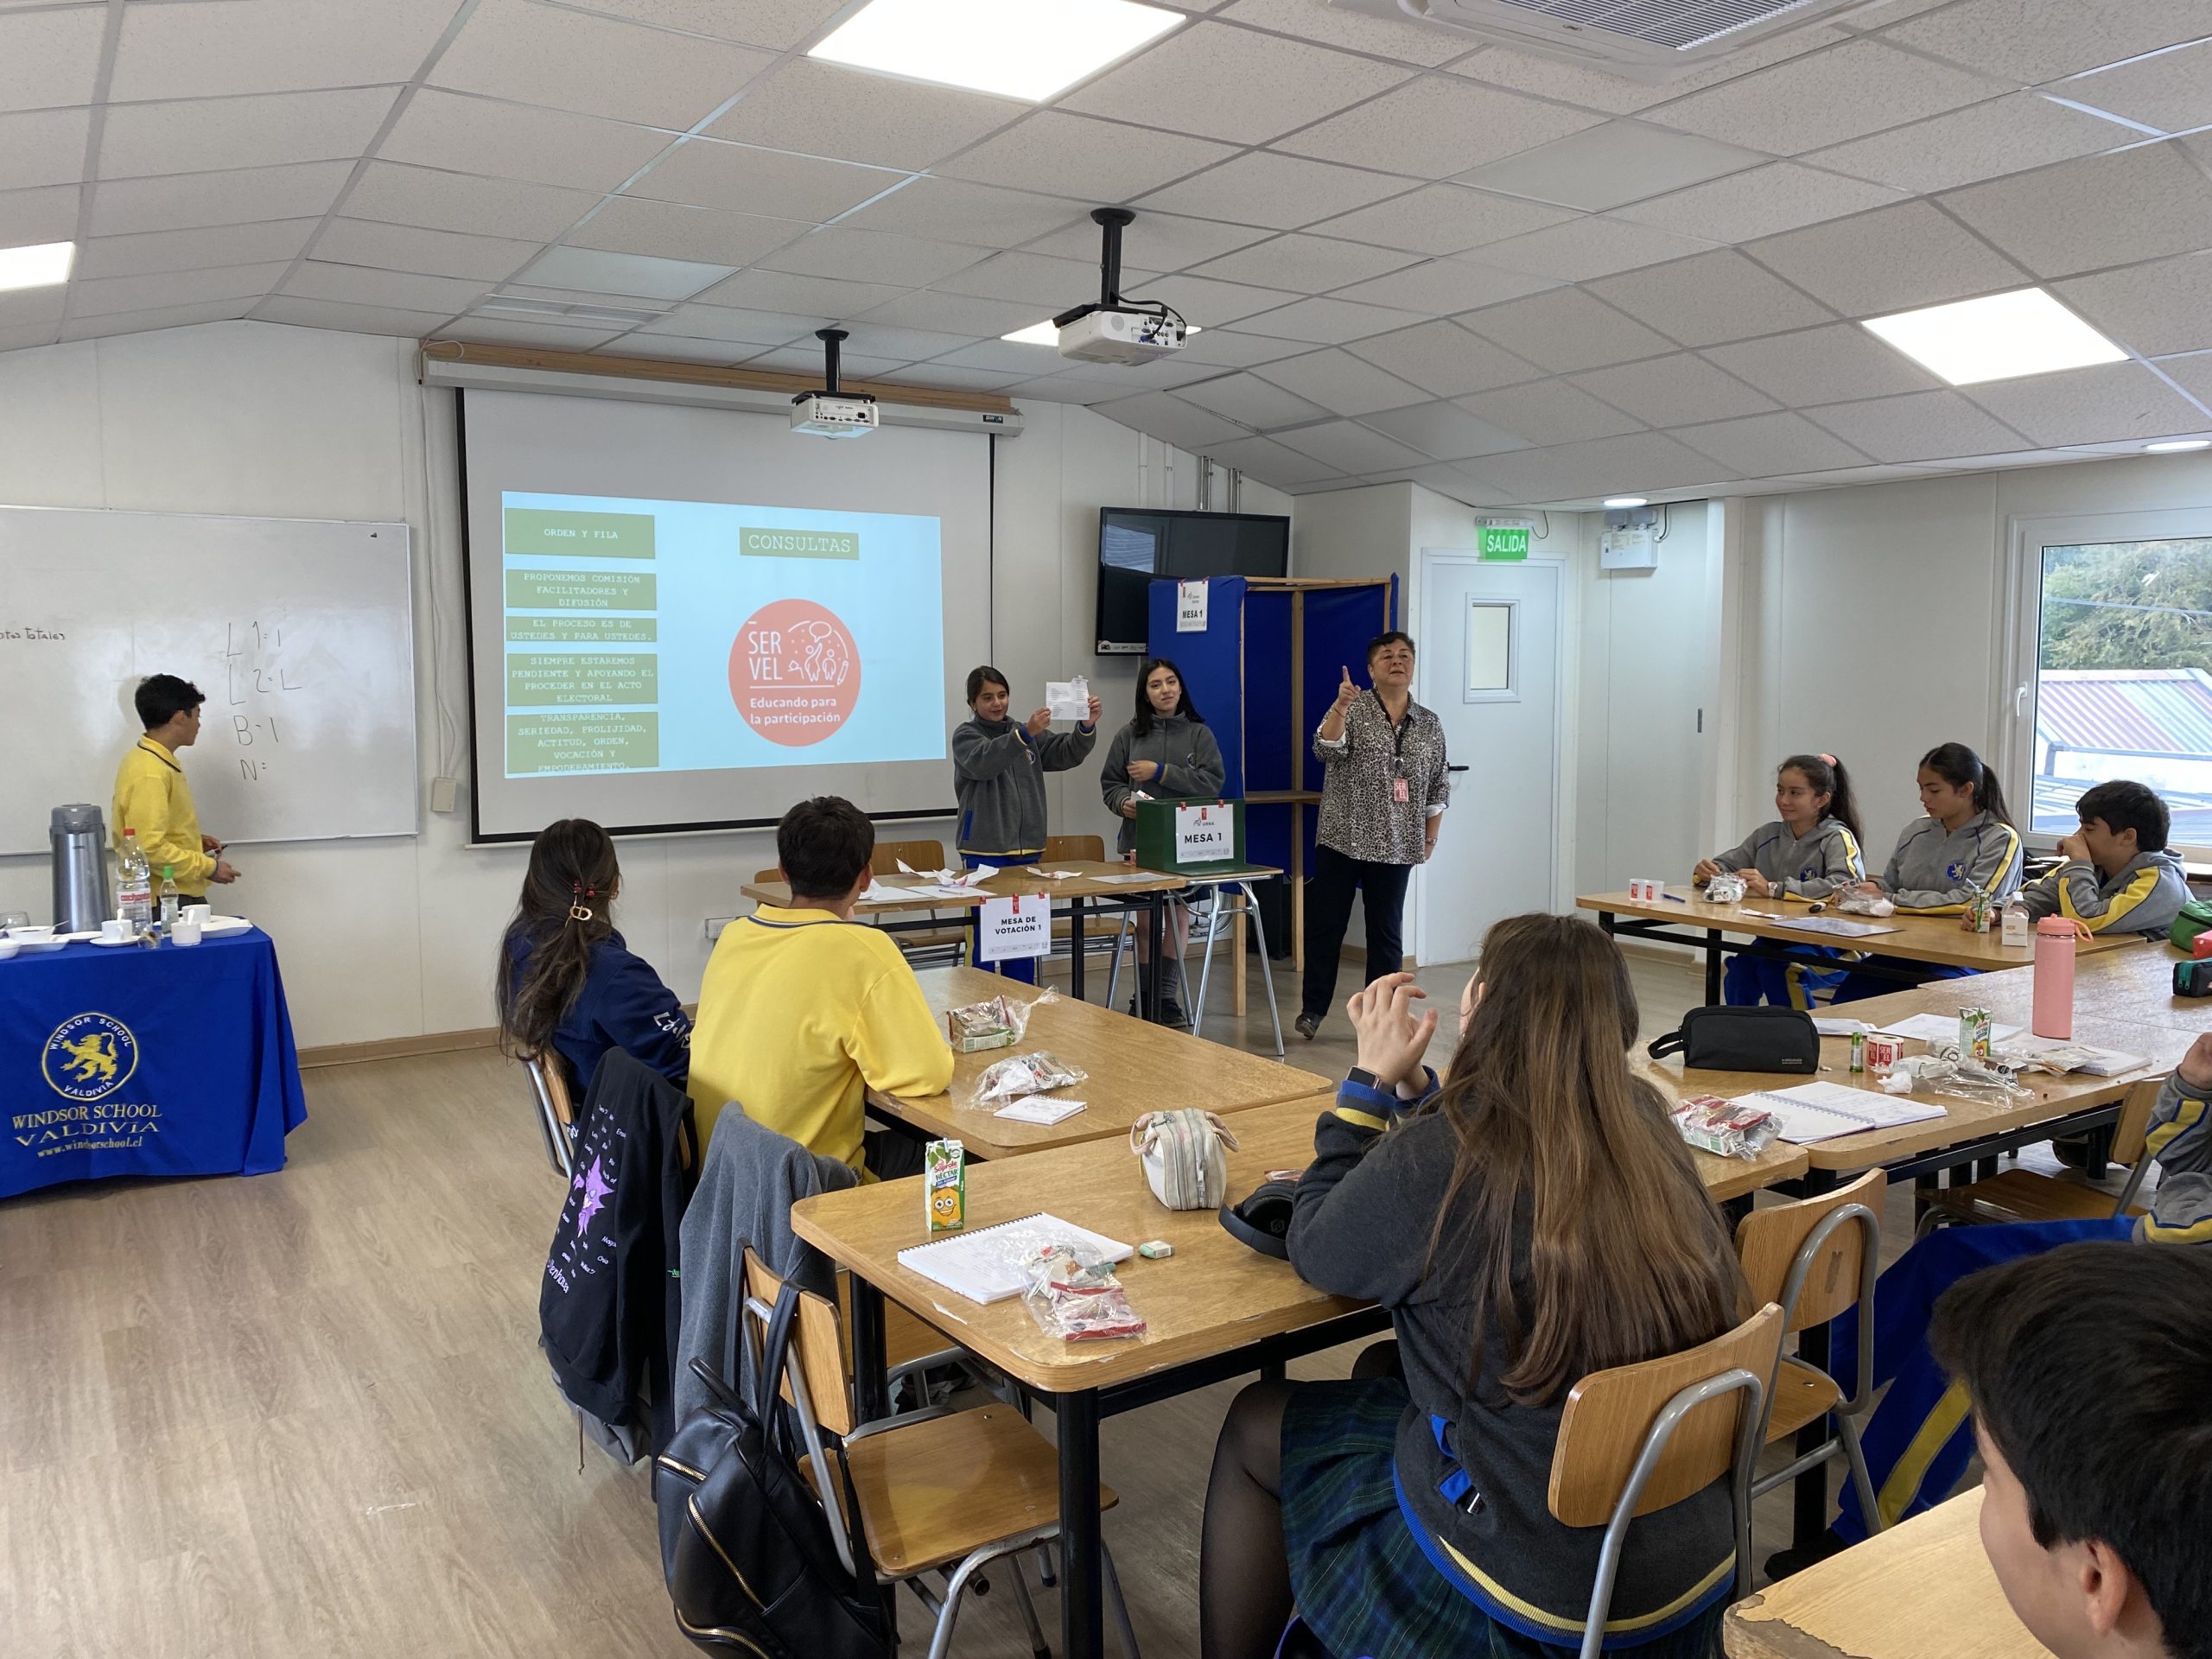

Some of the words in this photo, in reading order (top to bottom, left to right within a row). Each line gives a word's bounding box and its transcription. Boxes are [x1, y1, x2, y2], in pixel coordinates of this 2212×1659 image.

[543, 528, 575, 537] ORDEN
[594, 531, 618, 539] FILA
[748, 534, 851, 553] CONSULTAS
[1487, 535, 1526, 552] SALIDA
[524, 573, 586, 582] PROPONEMOS
[592, 574, 640, 584] COMISIÓN
[537, 587, 616, 595] FACILITADORES
[559, 597, 607, 607] DIFUSIÓN
[1182, 610, 1198, 619] MESA
[1199, 609, 1202, 618] 1
[533, 620, 545, 628] EL
[511, 632, 556, 641] USTEDES
[748, 631, 781, 655] SER
[581, 657, 635, 665] ESTAREMOS
[749, 657, 783, 681] VEL
[525, 682, 575, 690] PROCEDER
[556, 694, 612, 703] ELECTORAL
[750, 696, 809, 707] Educando
[811, 698, 836, 709] para
[750, 714, 760, 724] la
[765, 712, 840, 726] participación
[554, 749, 603, 760] VOCACIÓN
[1185, 834, 1213, 843] MESA
[995, 925, 1035, 935] VOTACIÓN
[49, 1016, 91, 1051] WINDSOR
[99, 1018, 132, 1047] SCHOOL
[63, 1081, 114, 1097] VALDIVIA
[12, 1105, 89, 1130] WINDSOR
[93, 1103, 162, 1119] SCHOOL
[14, 1121, 161, 1147] VALDIVIA
